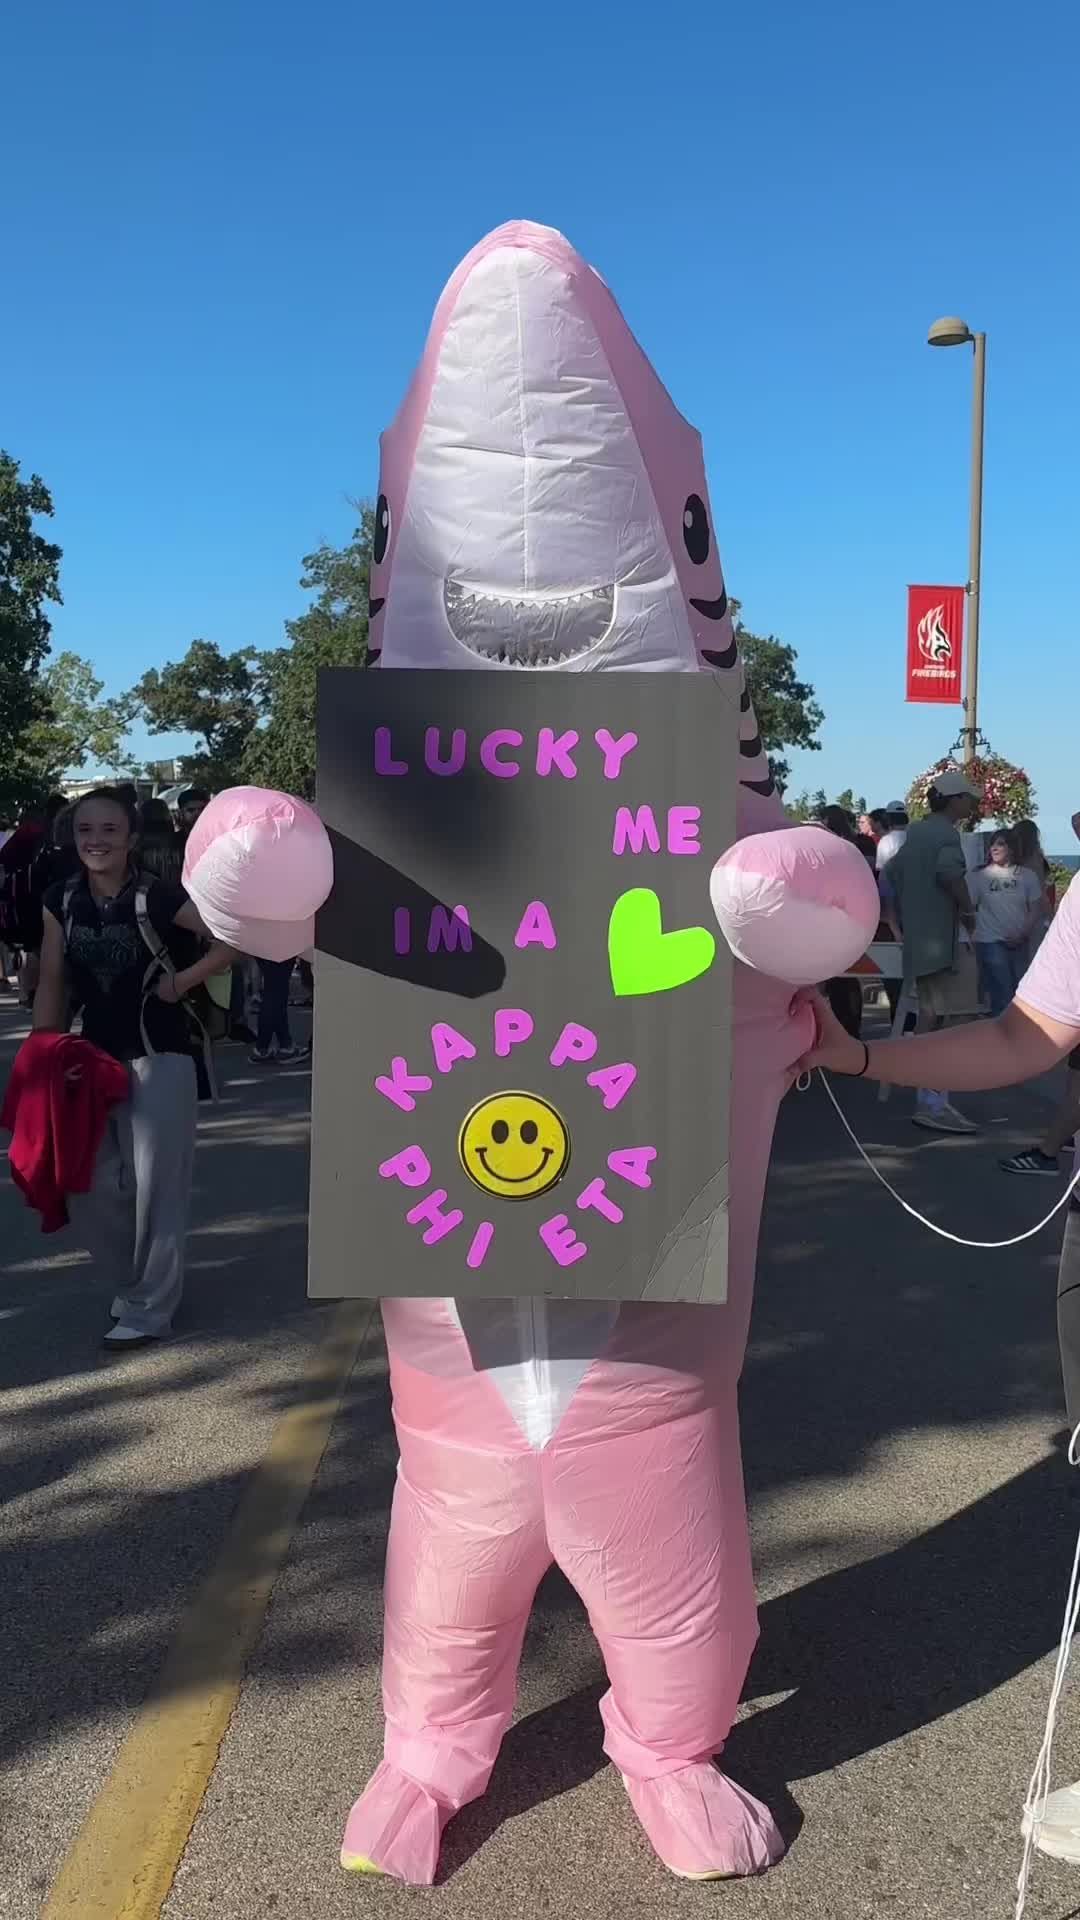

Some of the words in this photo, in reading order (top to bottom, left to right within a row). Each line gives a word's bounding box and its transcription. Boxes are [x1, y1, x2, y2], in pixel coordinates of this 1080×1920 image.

[374, 726, 640, 781] LUCKY
[612, 804, 704, 857] ME
[394, 902, 473, 955] IM
[514, 900, 559, 951] A
[374, 1007, 639, 1114] KAPPA
[378, 1144, 497, 1271] PHI
[537, 1145, 658, 1269] ETA
